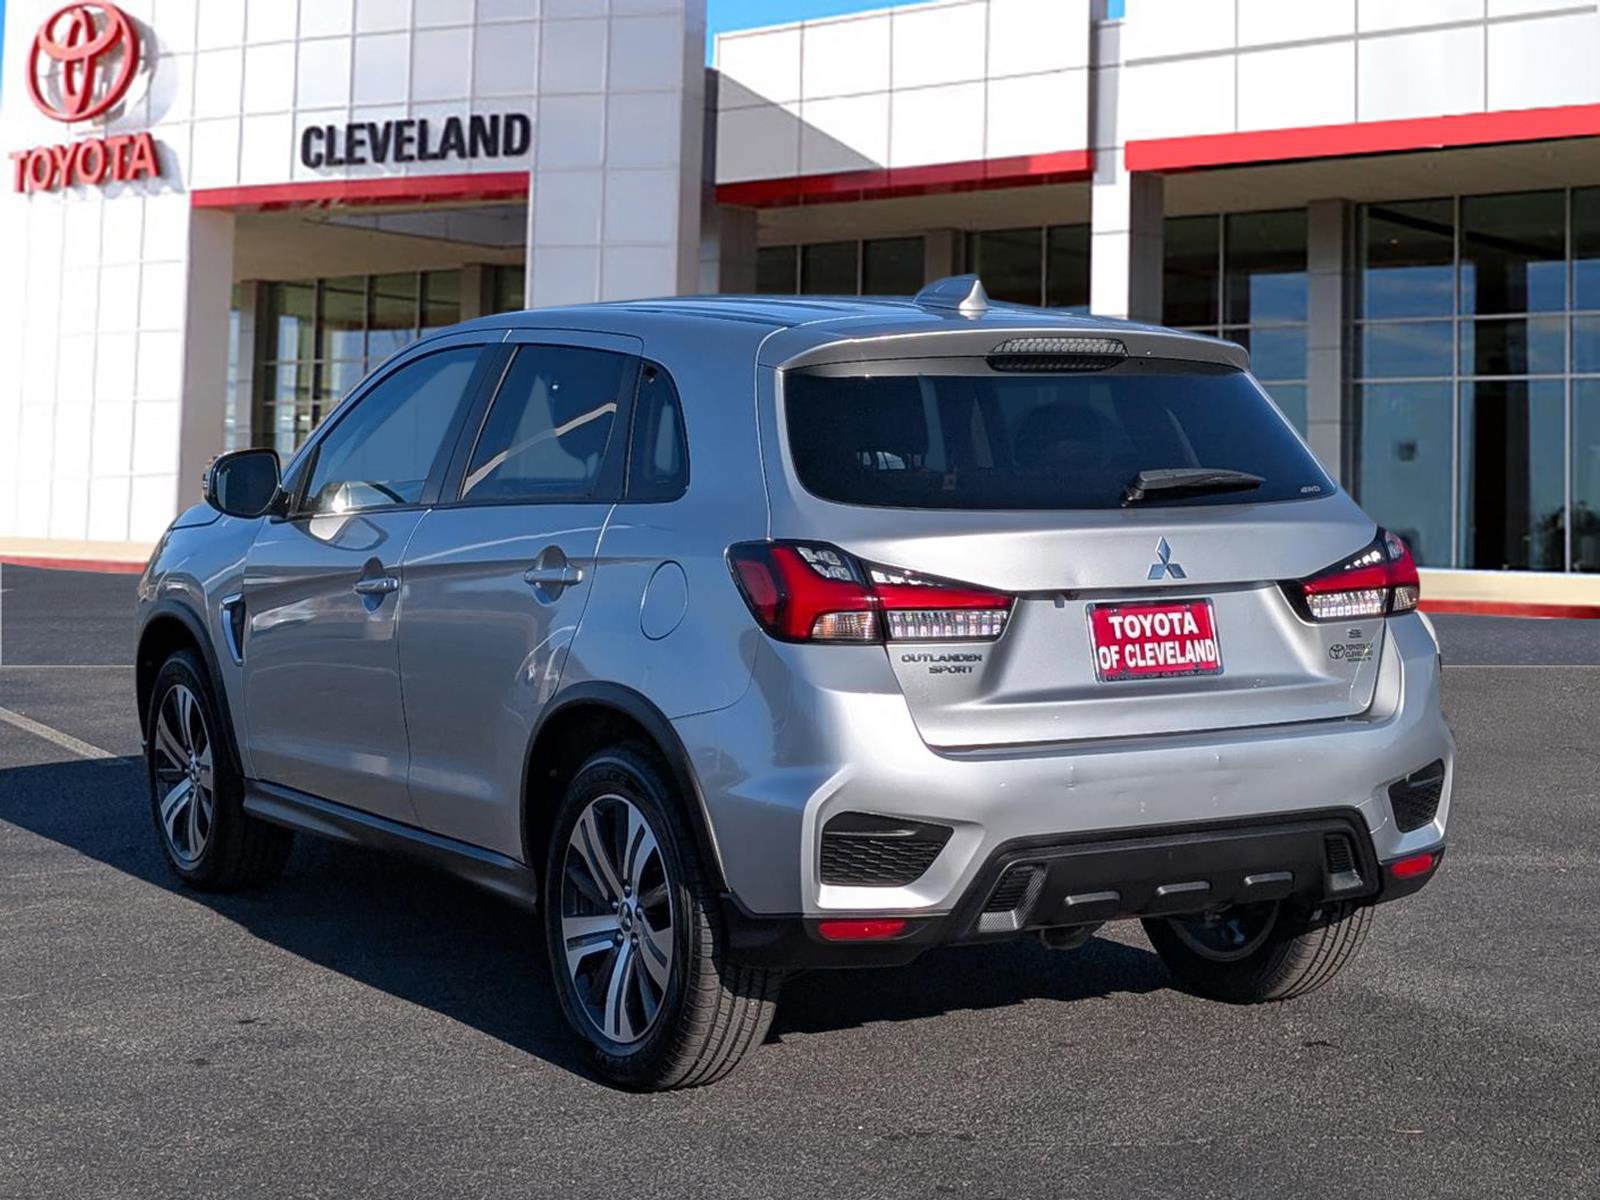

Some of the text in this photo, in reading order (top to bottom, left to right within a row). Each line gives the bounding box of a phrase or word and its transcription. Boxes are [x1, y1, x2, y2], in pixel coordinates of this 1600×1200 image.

[301, 113, 532, 169] CLEVELAND
[9, 132, 159, 193] TOYOTA
[1108, 611, 1199, 640] TOYOTA
[901, 653, 983, 662] OUTLANDER
[1098, 638, 1216, 670] OF CLEVELAND
[928, 665, 973, 674] SPORT
